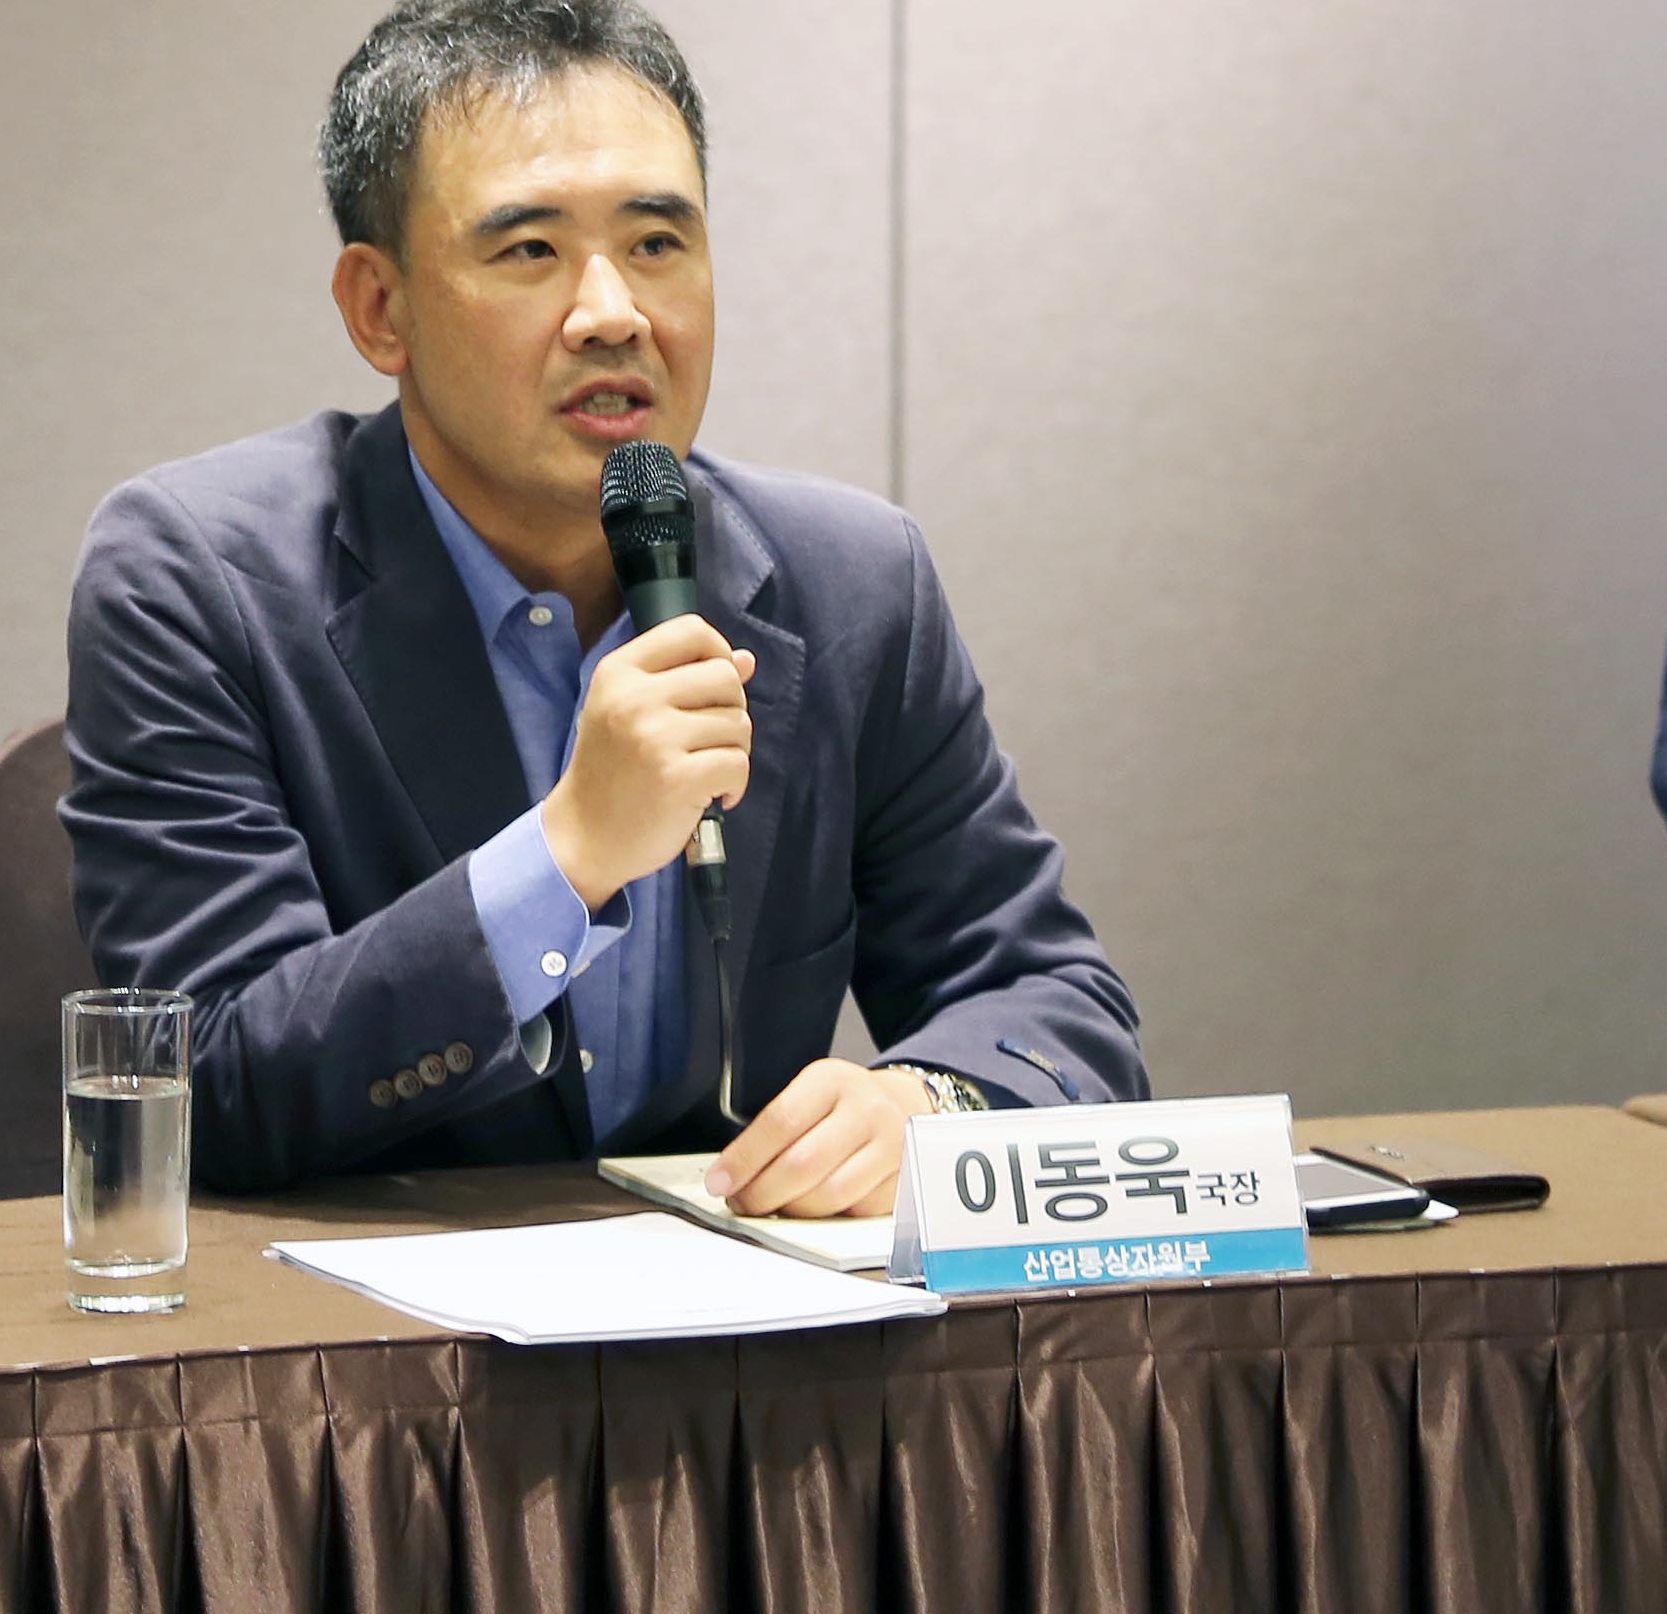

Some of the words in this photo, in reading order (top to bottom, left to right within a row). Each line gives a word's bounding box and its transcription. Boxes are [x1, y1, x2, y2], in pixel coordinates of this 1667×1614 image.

[954, 1135, 1191, 1226] 이동욱
[1195, 1169, 1261, 1207] 국장
[1022, 1240, 1212, 1283] 산업통상자원부
